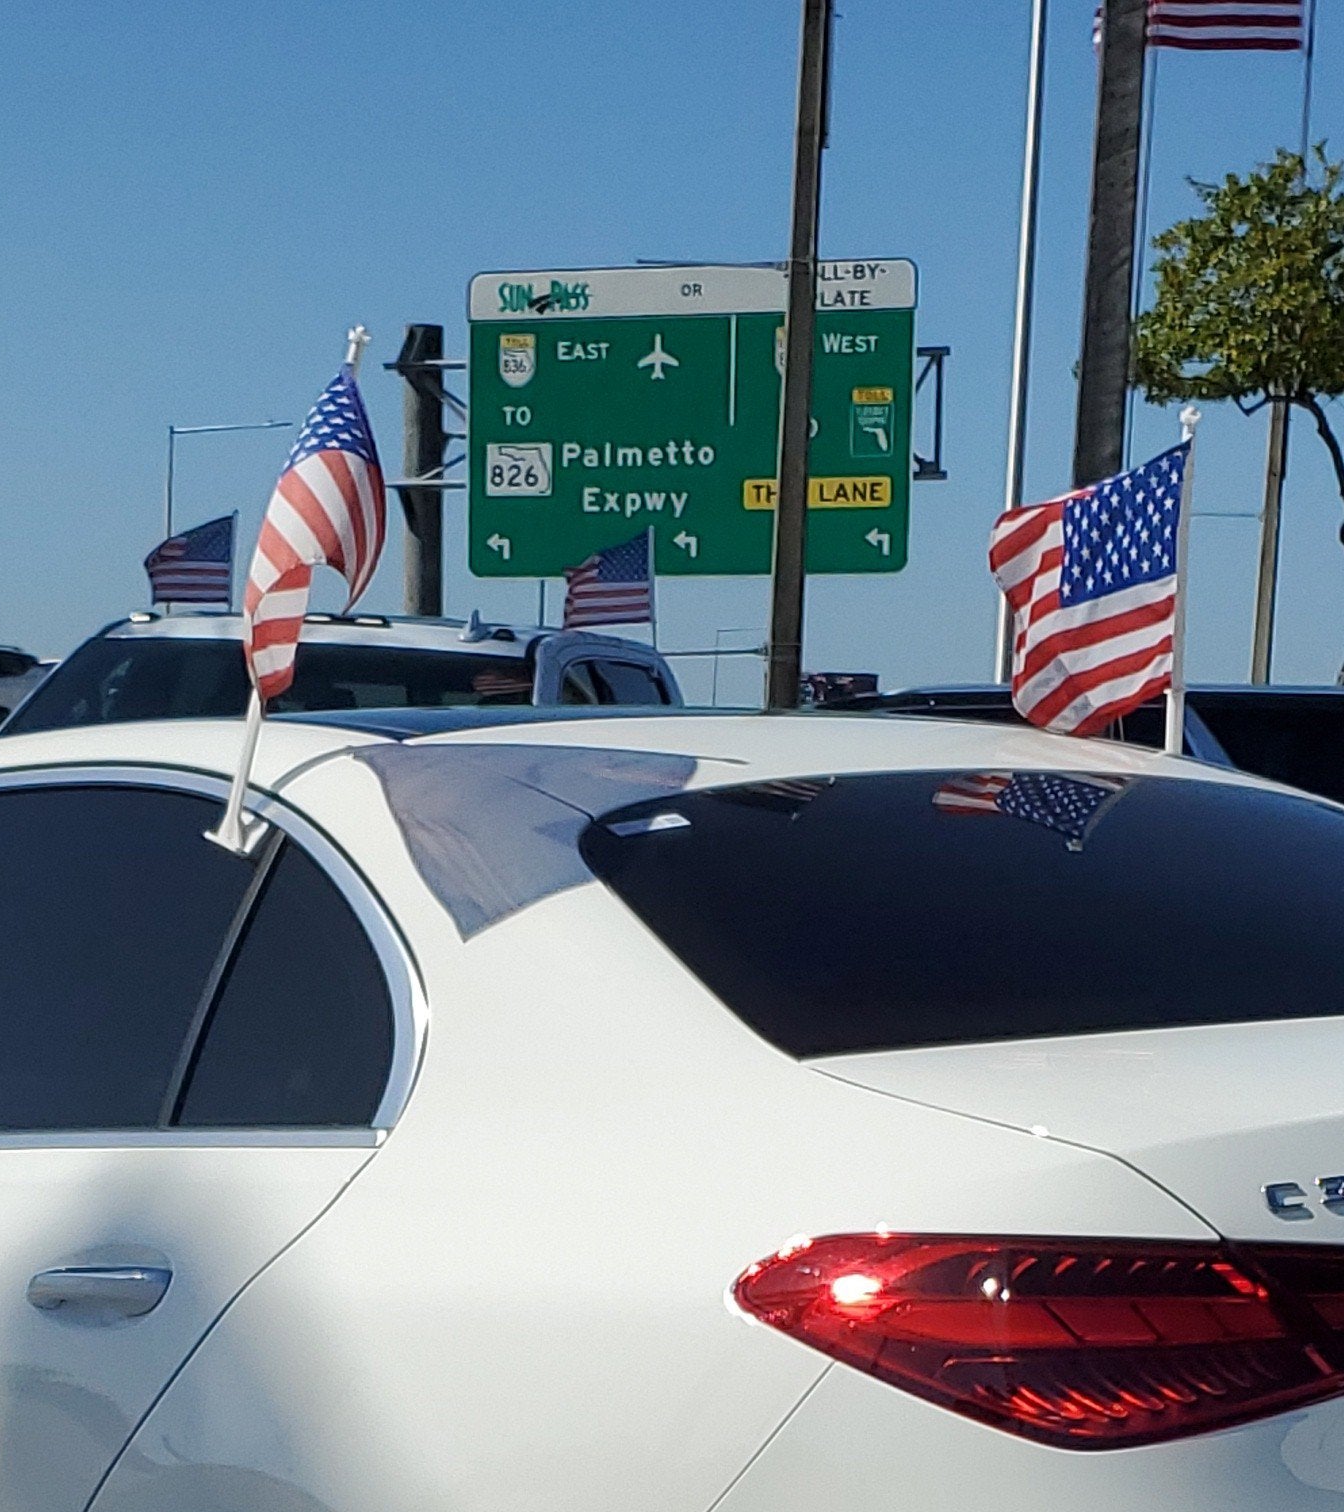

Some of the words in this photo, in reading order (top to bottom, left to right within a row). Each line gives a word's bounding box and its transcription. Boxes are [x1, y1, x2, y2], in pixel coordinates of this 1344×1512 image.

[819, 263, 887, 281] LL-BY-
[681, 284, 703, 297] OR
[820, 289, 872, 307] LATE
[557, 341, 610, 360] EAST
[822, 333, 879, 353] WEST
[502, 405, 532, 426] TO
[561, 440, 715, 468] Palmetto
[490, 464, 539, 487] 826
[582, 486, 689, 518] Expwy
[819, 482, 884, 502] LANE
[1261, 1181, 1307, 1209] C
